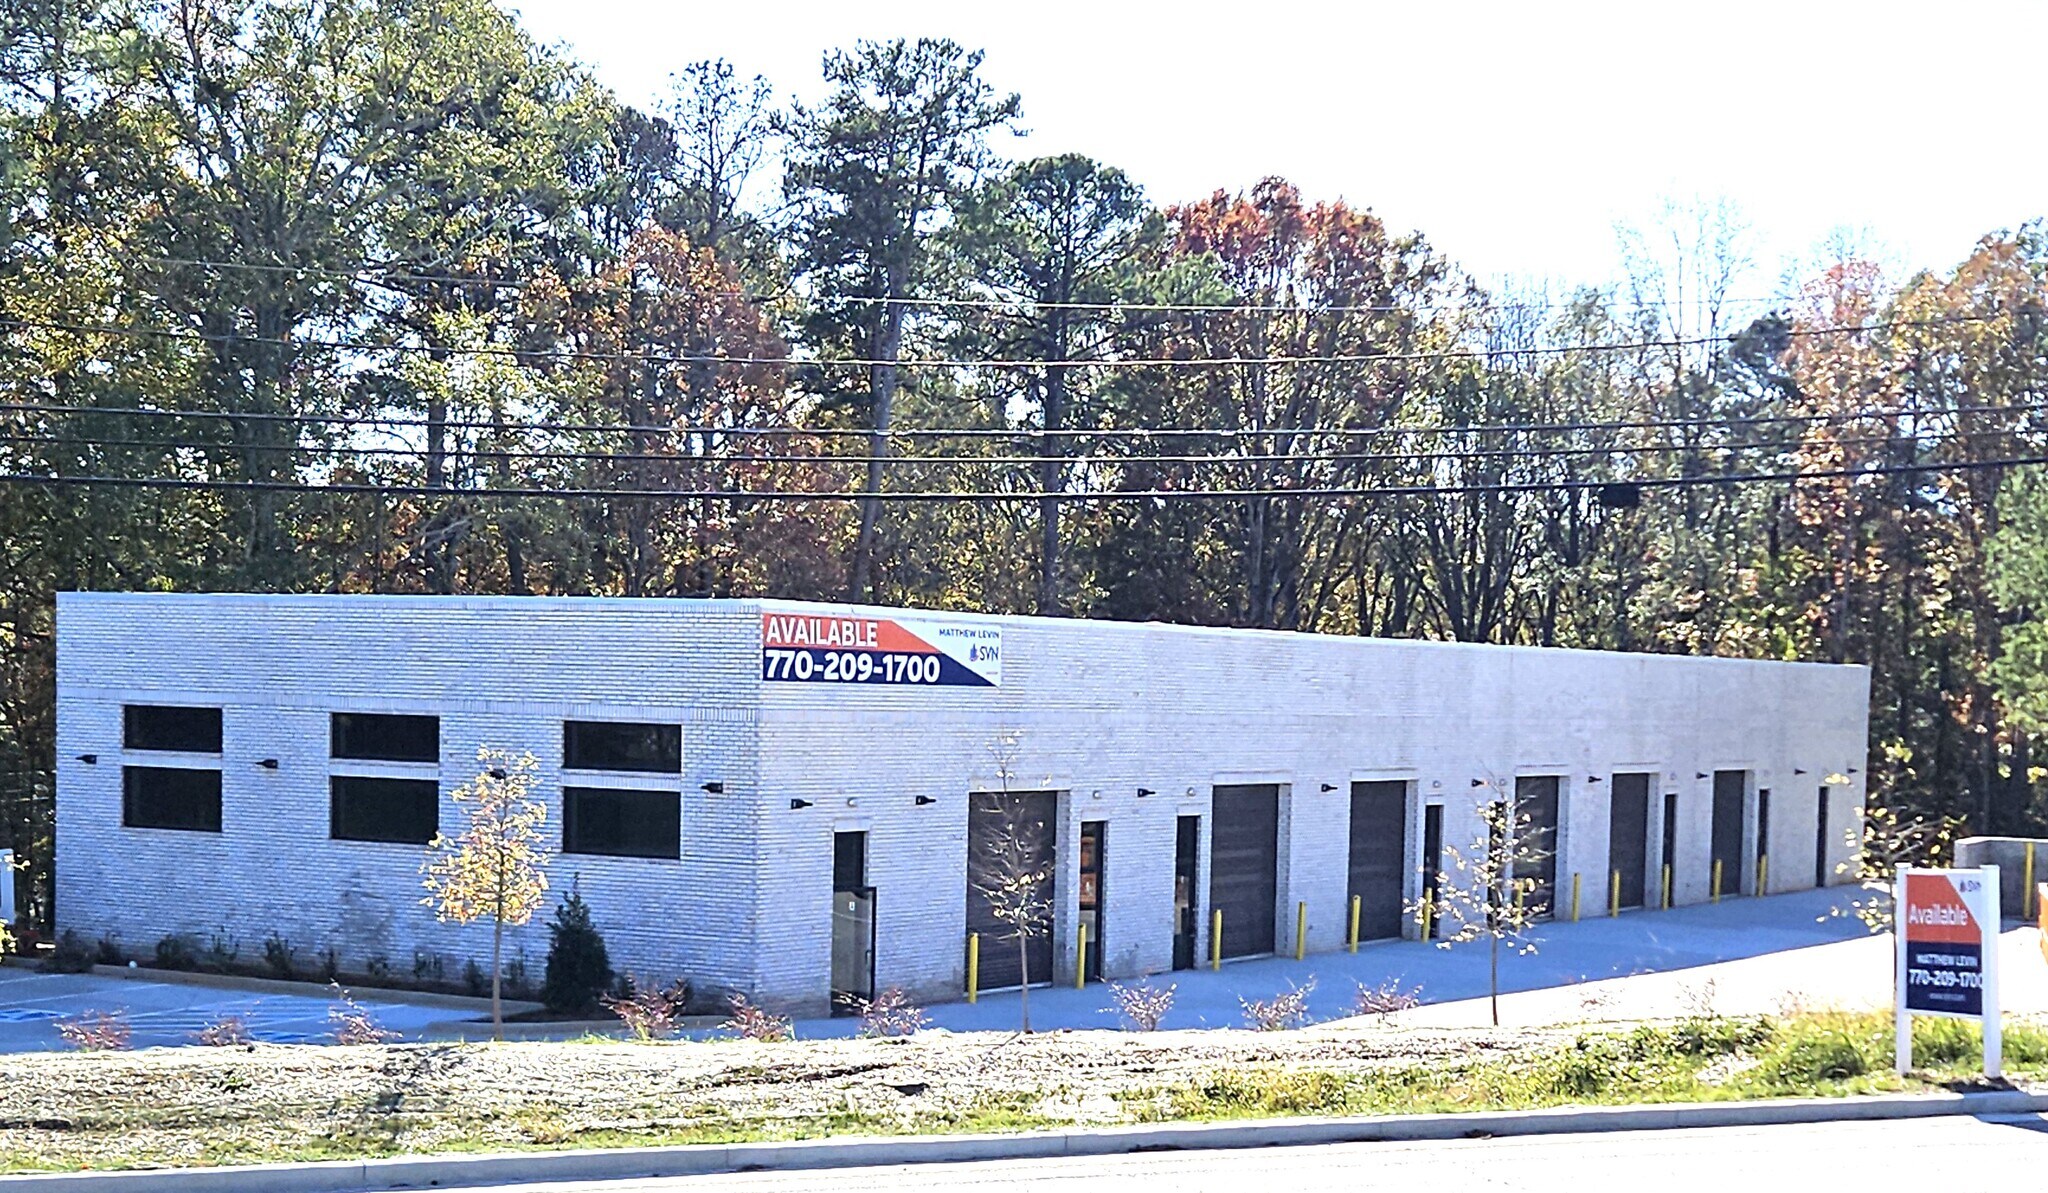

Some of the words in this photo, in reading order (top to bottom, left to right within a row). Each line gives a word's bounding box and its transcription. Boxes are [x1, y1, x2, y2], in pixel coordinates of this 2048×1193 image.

[767, 617, 878, 647] AVAILABLE
[939, 628, 976, 638] MATTHEW
[978, 630, 1000, 639] LEVIN
[979, 645, 999, 662] SVN
[766, 650, 940, 682] 770-209-1700
[1909, 903, 1968, 926] Available
